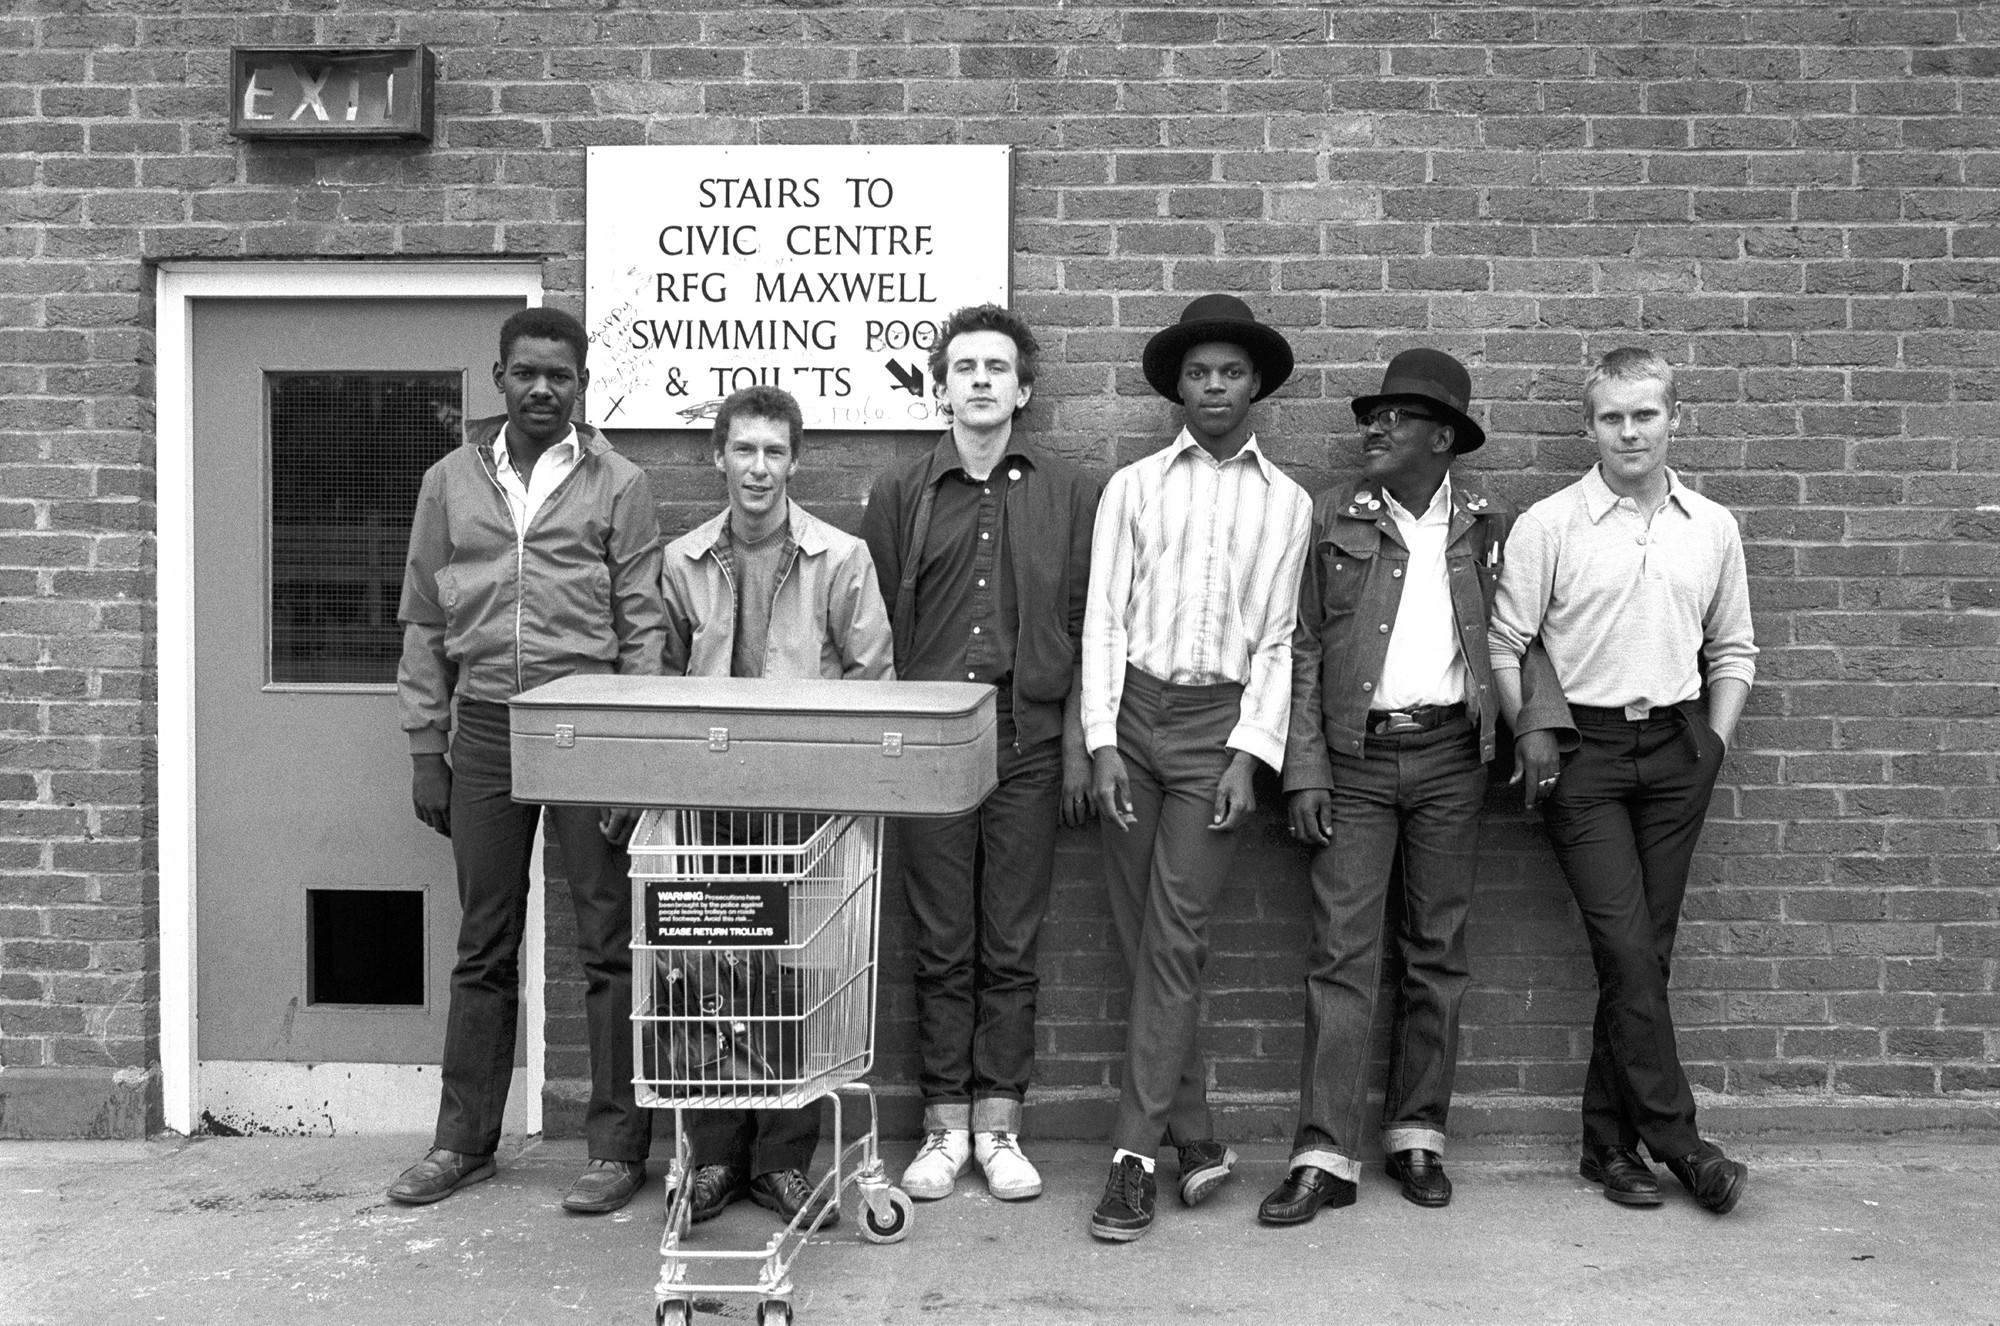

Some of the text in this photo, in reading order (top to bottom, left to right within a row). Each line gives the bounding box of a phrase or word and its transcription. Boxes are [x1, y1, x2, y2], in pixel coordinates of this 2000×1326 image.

[699, 177, 893, 208] STAIRS TO
[658, 225, 933, 256] CIVIC CENTRE
[755, 272, 937, 303] MAXWELL
[632, 319, 836, 350] SWIMMING
[865, 319, 949, 350] POO
[665, 366, 690, 397] &
[658, 891, 704, 901] WARNING
[675, 901, 699, 910] brought
[700, 901, 708, 910] by
[720, 901, 740, 909] police
[740, 901, 764, 909] against
[658, 927, 773, 937] PLEASE RETURN TROLLEYS
